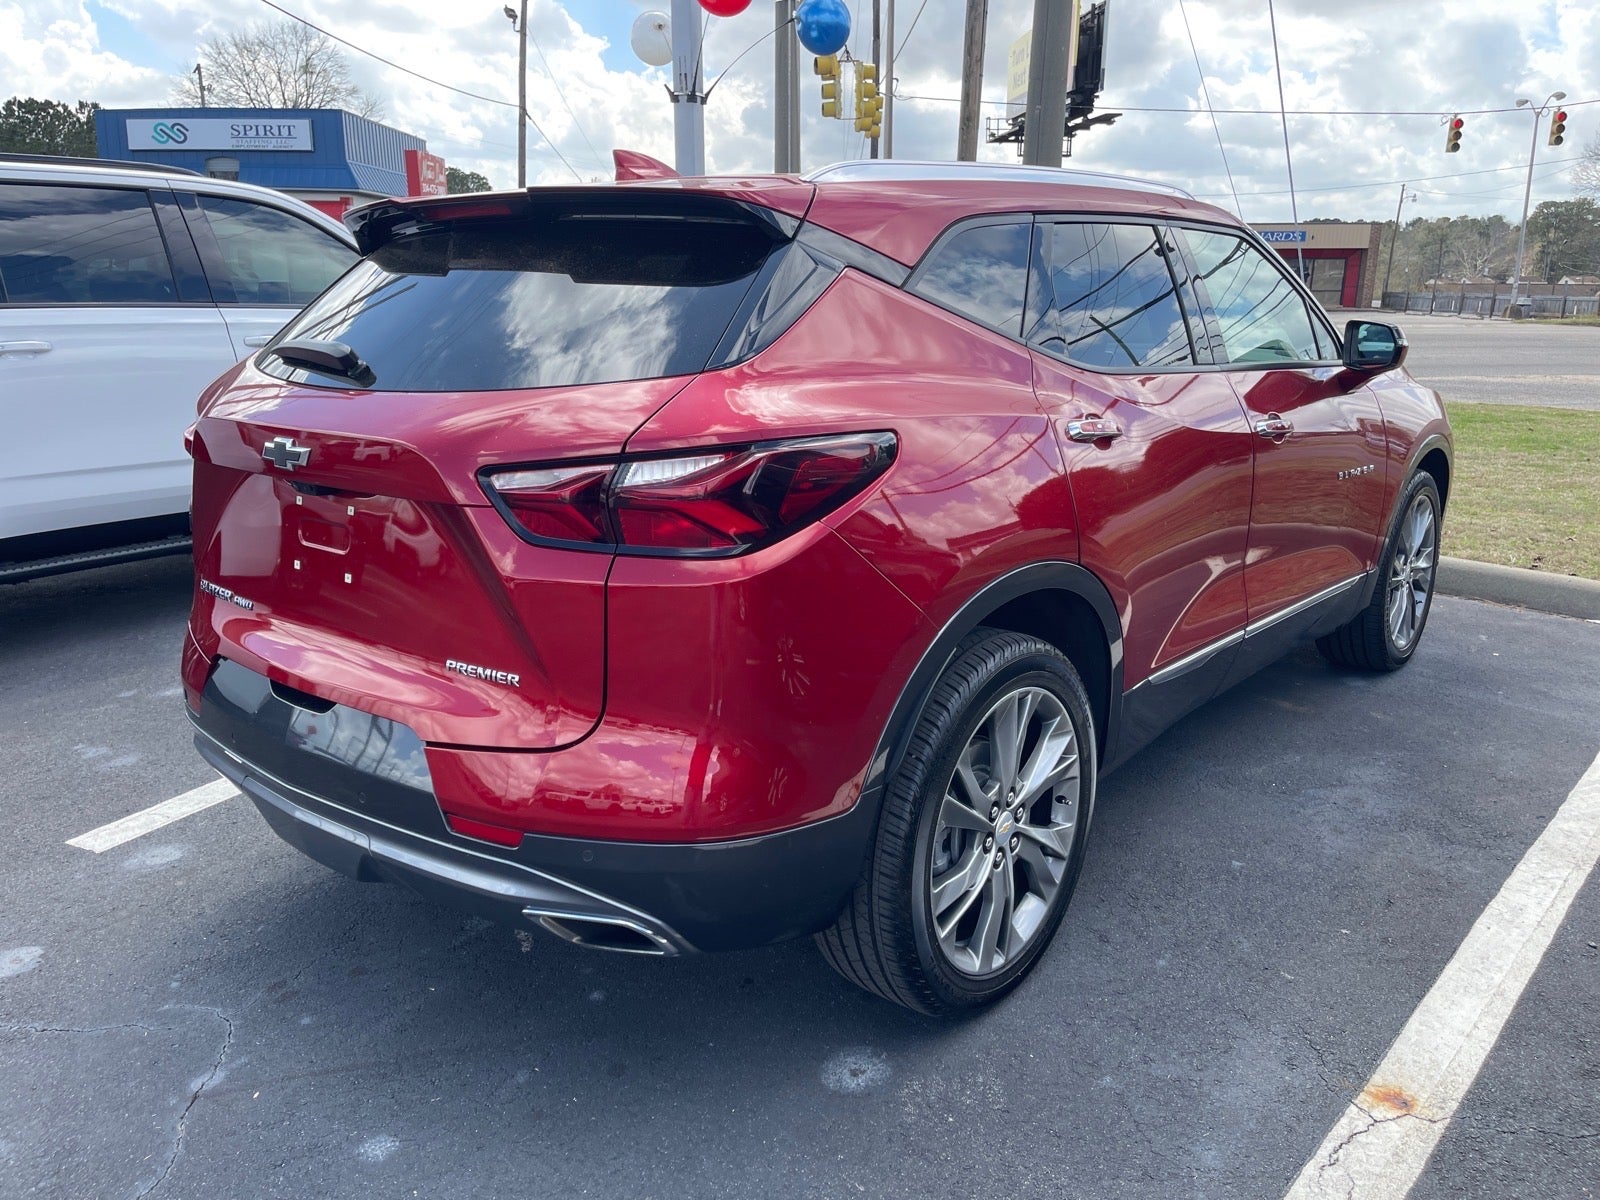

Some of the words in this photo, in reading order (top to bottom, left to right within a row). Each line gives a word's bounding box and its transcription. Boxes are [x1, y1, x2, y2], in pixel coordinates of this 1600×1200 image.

[230, 124, 296, 137] SPIRIT
[200, 578, 232, 603] BLAZER
[233, 595, 254, 611] AWD
[445, 659, 521, 688] PREMIER
